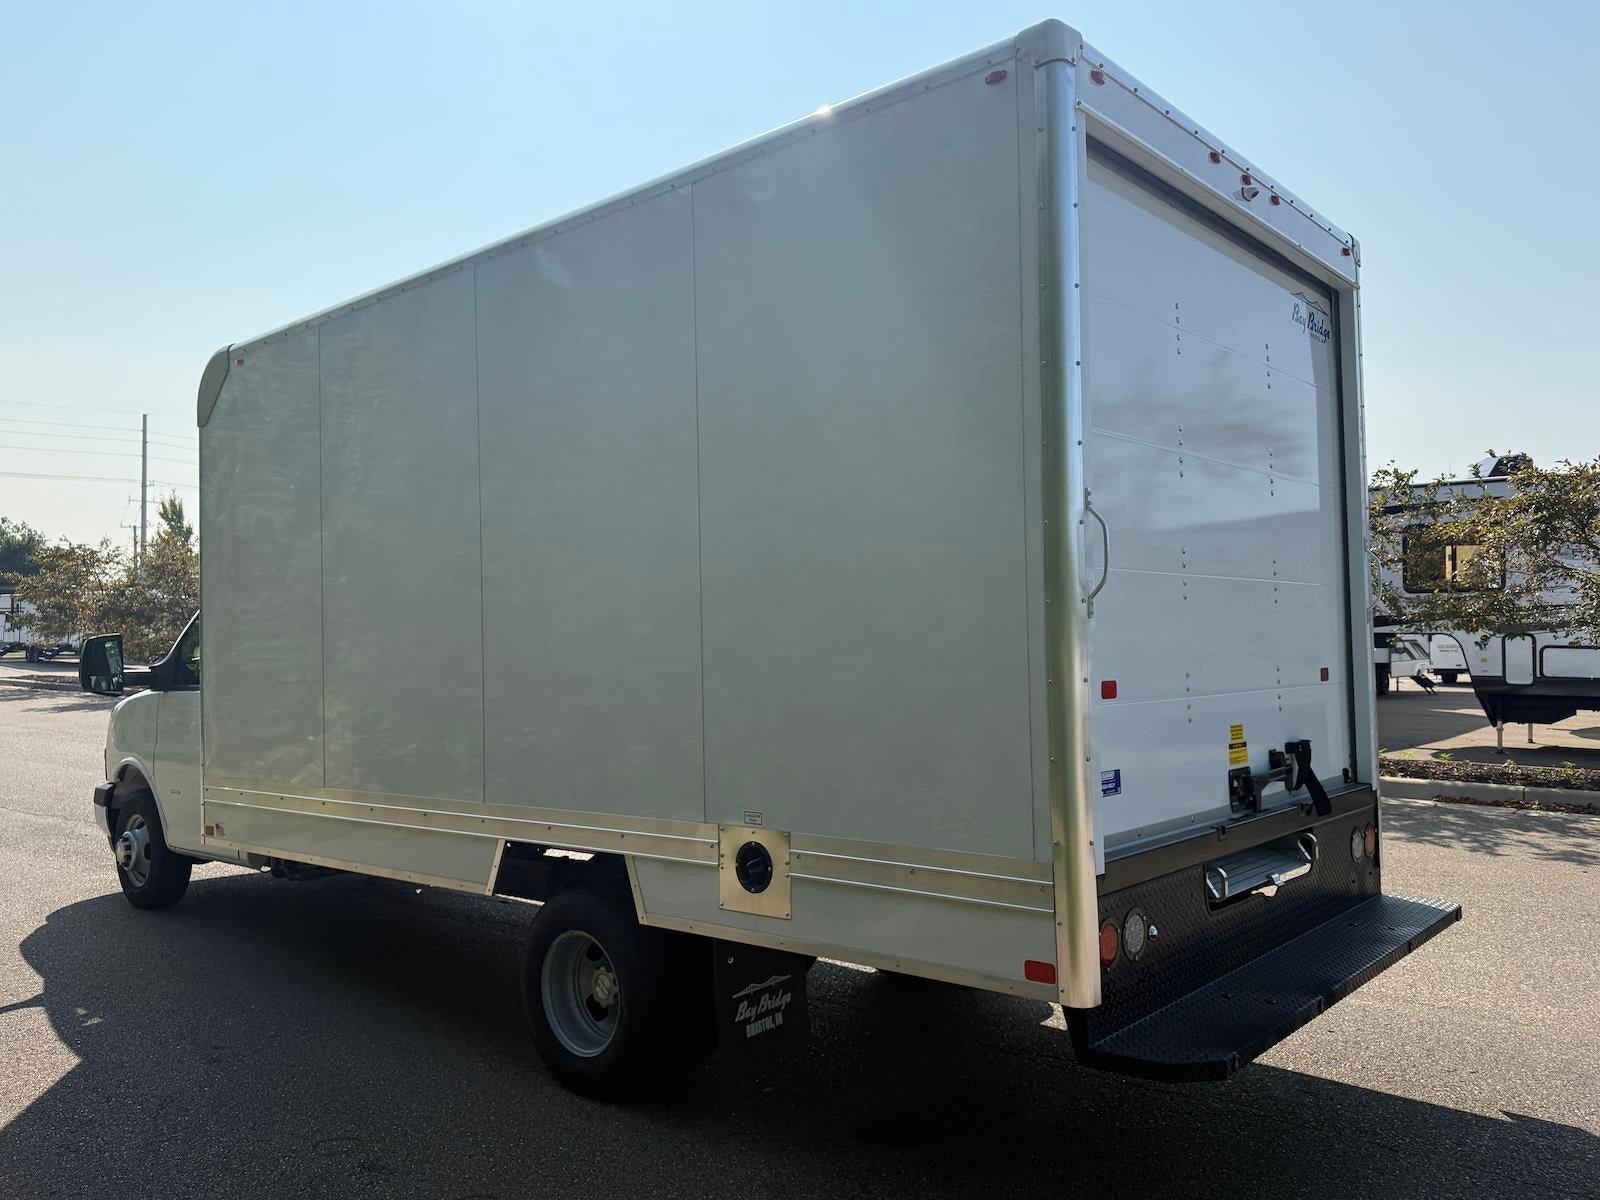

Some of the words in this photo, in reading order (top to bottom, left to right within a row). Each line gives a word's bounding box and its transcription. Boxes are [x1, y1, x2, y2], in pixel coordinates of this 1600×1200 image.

[1292, 303, 1307, 334] Bay
[1307, 311, 1330, 343] Bridge
[735, 1000, 758, 1023] Bay
[757, 989, 792, 1014] Bridge
